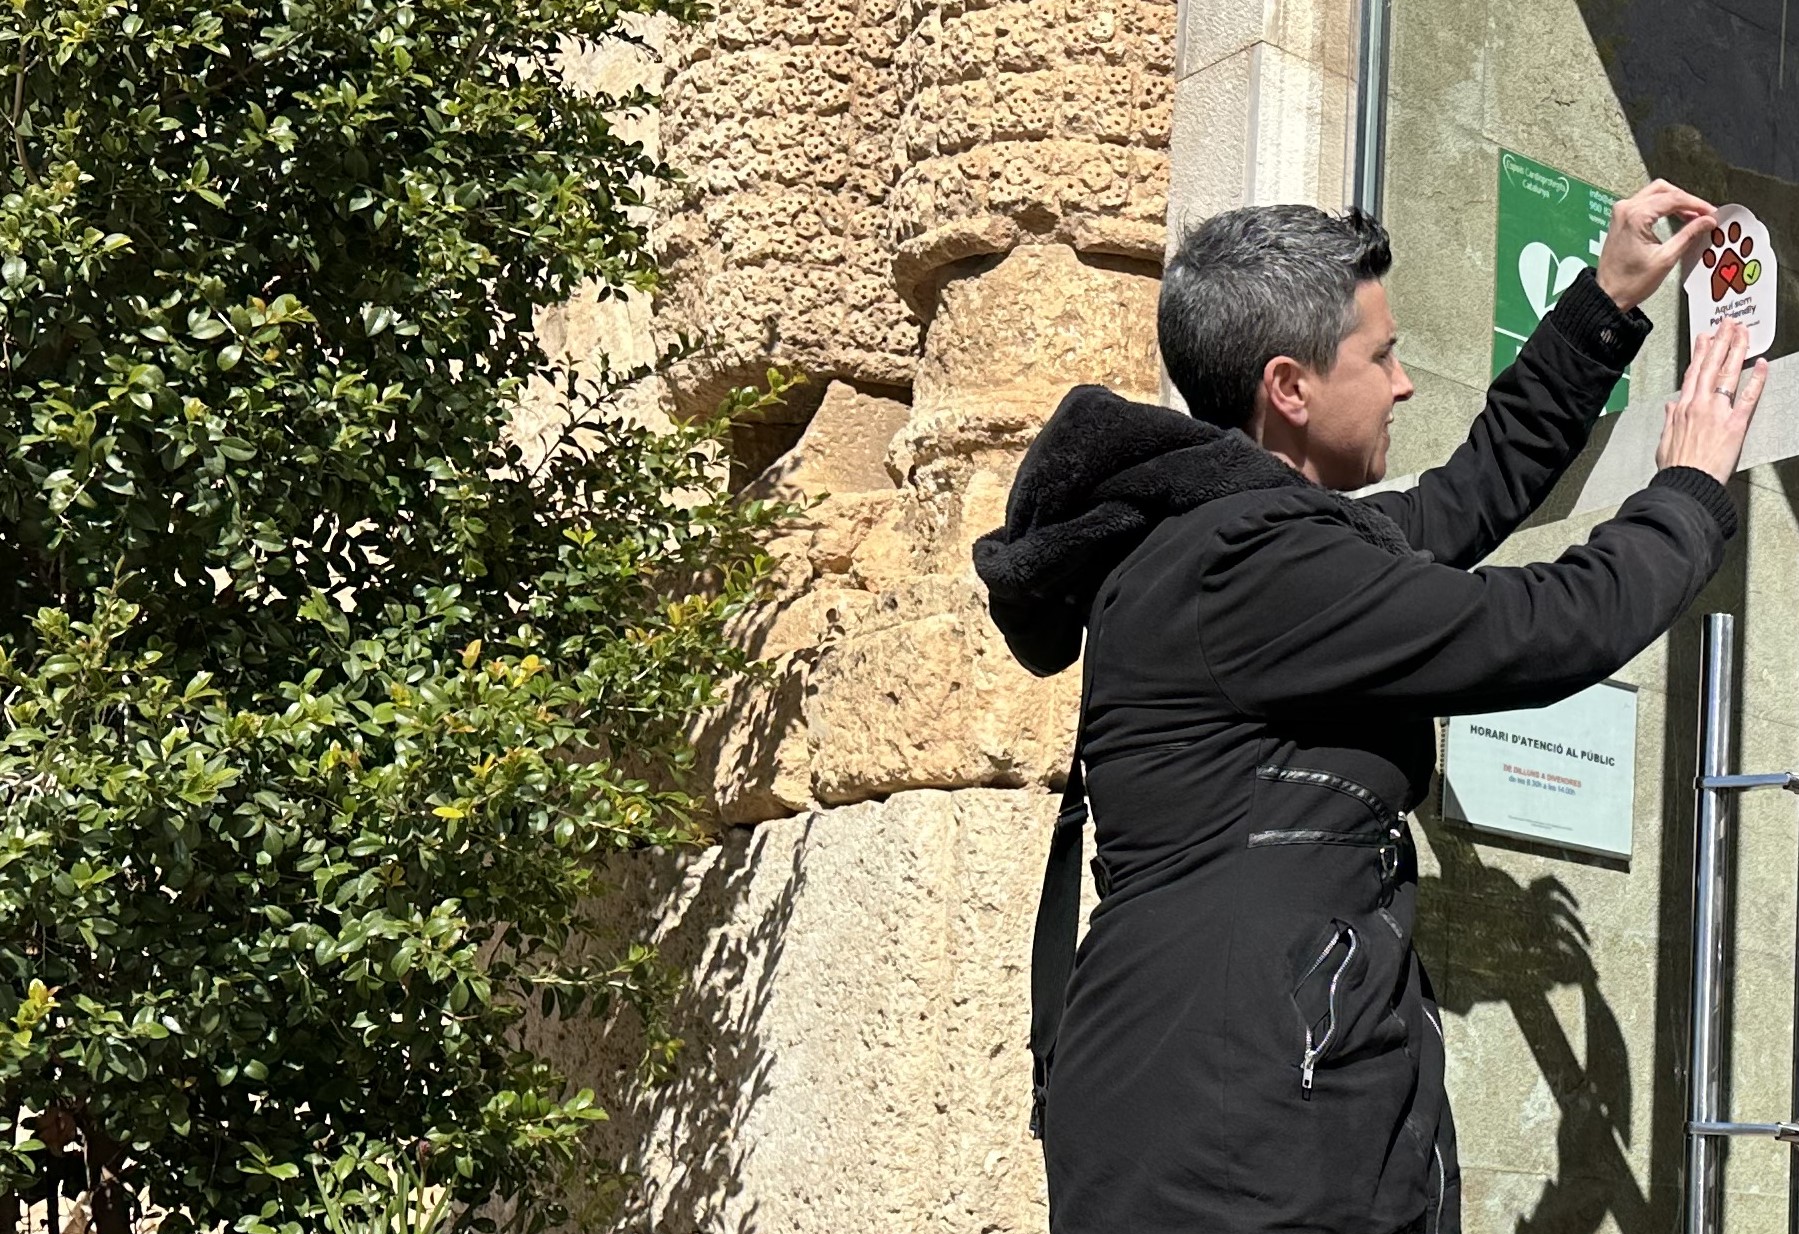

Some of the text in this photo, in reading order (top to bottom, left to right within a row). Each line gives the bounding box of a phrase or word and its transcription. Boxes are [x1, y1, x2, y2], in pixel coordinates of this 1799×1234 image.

[1470, 724, 1615, 767] HORARI D'ATENCIÓ AL PÚBLIC
